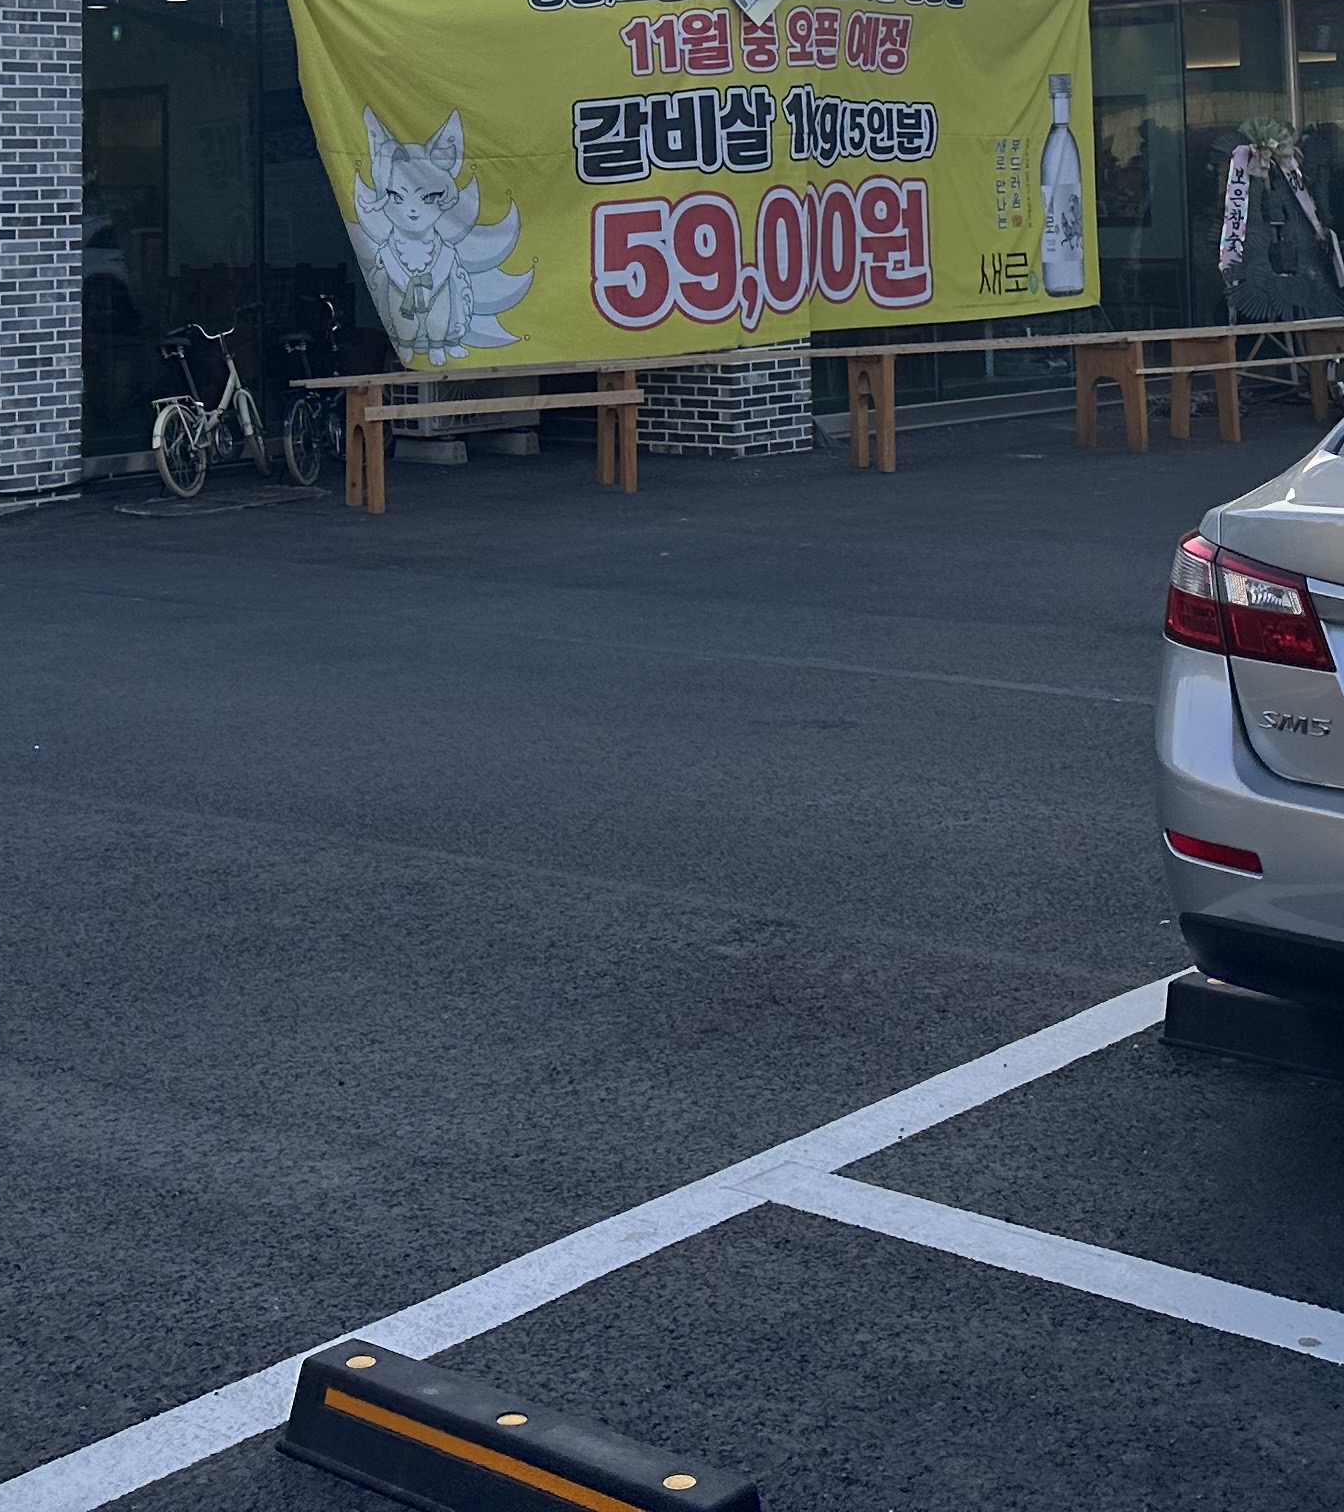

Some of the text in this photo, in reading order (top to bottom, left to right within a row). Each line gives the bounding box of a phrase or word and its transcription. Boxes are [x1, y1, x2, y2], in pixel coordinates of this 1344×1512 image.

[620, 6, 913, 76] 11월 중 오픈 예정
[572, 85, 775, 184] 갈비살
[979, 252, 1029, 295] 새로
[1258, 710, 1332, 737] SM5
